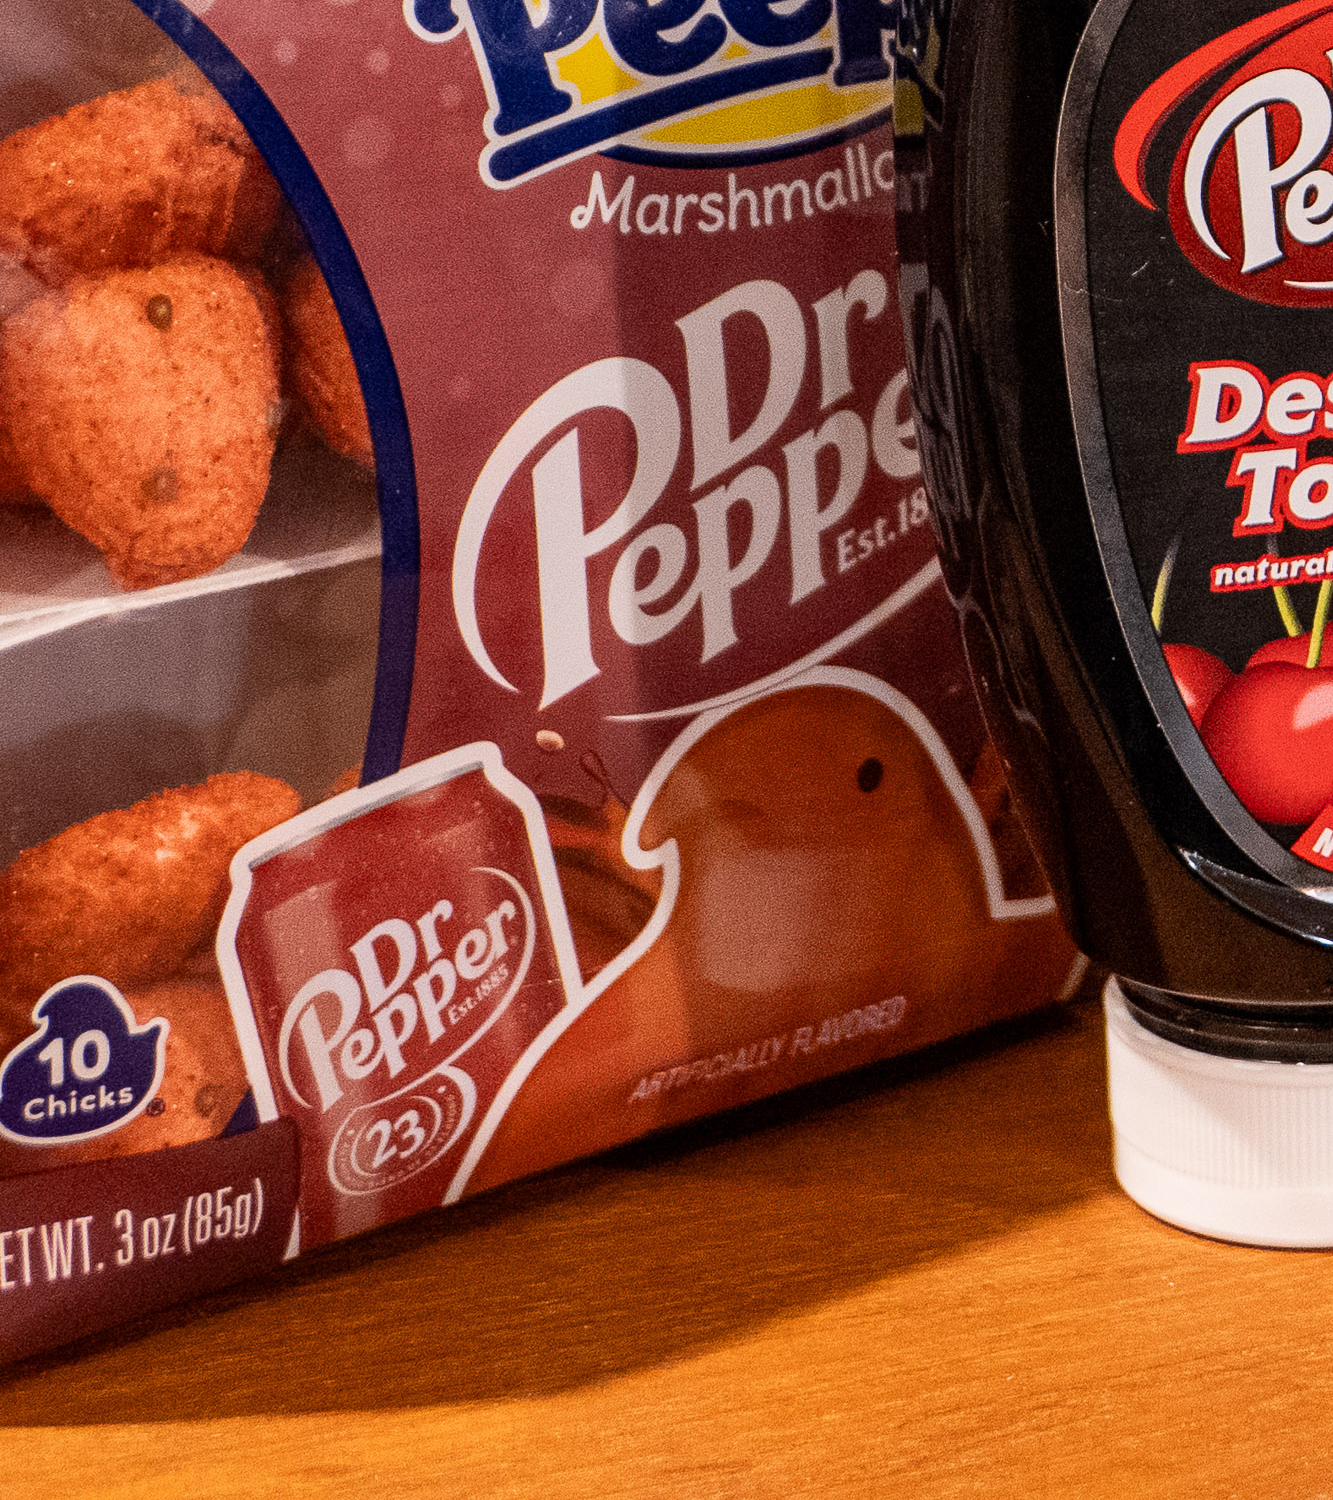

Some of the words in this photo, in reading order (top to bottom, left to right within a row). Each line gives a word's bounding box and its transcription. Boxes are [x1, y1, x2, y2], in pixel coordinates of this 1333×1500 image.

[571, 143, 898, 235] Marshmallo
[675, 268, 888, 492] Dr
[452, 354, 922, 713] Peppe
[836, 488, 930, 572] Est.18
[278, 899, 517, 1114] Pepper
[350, 899, 454, 1014] Dr
[23, 1084, 134, 1123] Chicks
[37, 1029, 111, 1088] 10
[365, 1108, 426, 1170] 23
[0, 1226, 35, 1291] ET
[40, 1214, 105, 1282] WT.
[114, 1208, 134, 1267] 3
[141, 1212, 177, 1260] oz
[183, 1177, 264, 1256] (85g)
